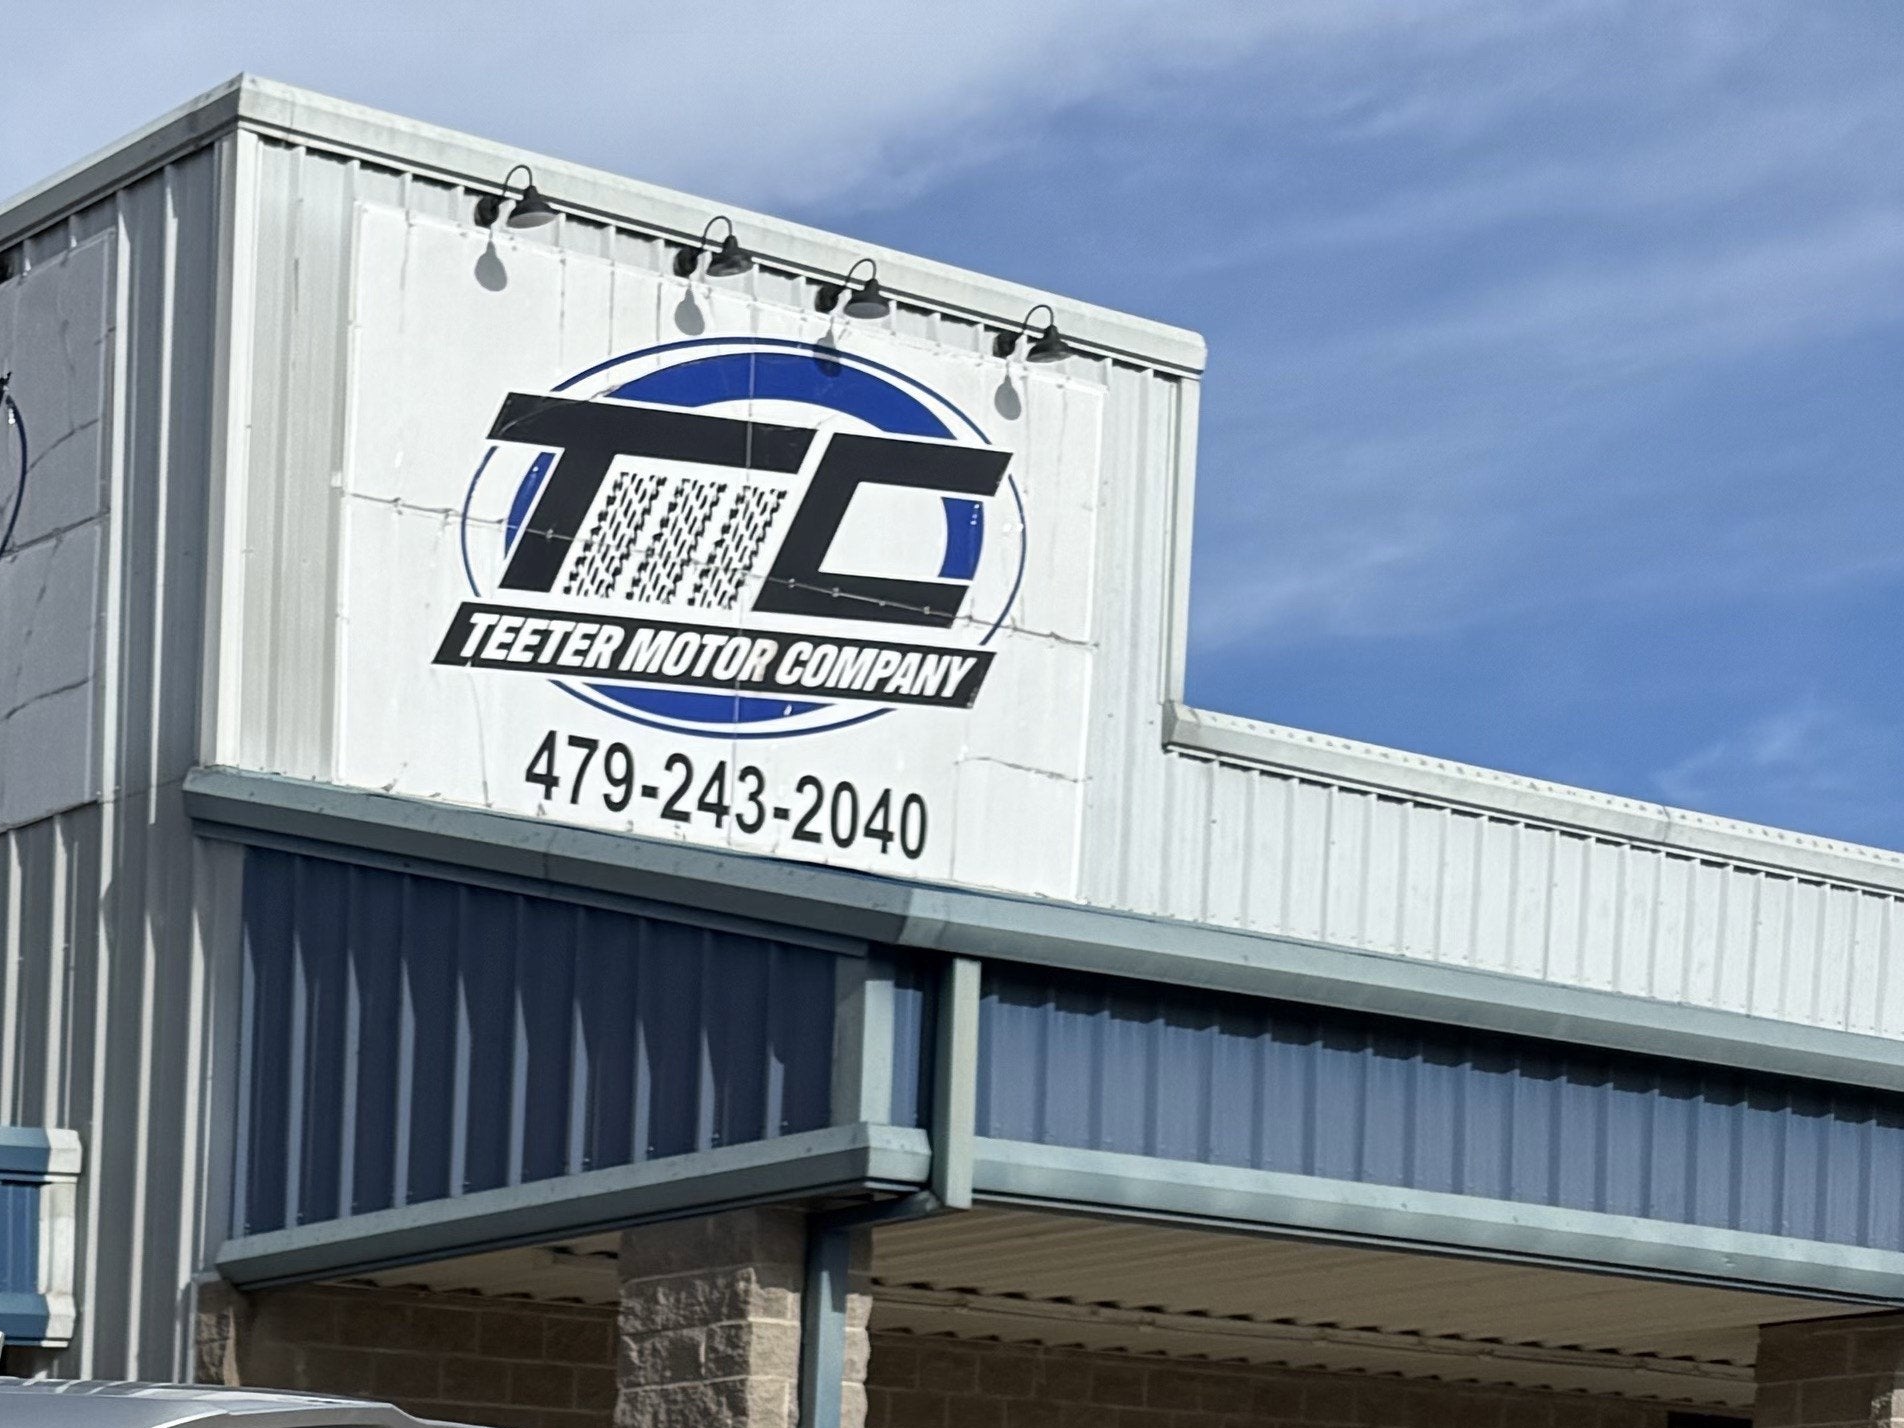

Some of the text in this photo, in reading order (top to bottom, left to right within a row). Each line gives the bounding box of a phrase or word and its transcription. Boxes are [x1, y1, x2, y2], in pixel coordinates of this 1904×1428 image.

[459, 612, 979, 698] TEETER MOTOR COMPANY
[525, 730, 929, 860] 479-243-2040
